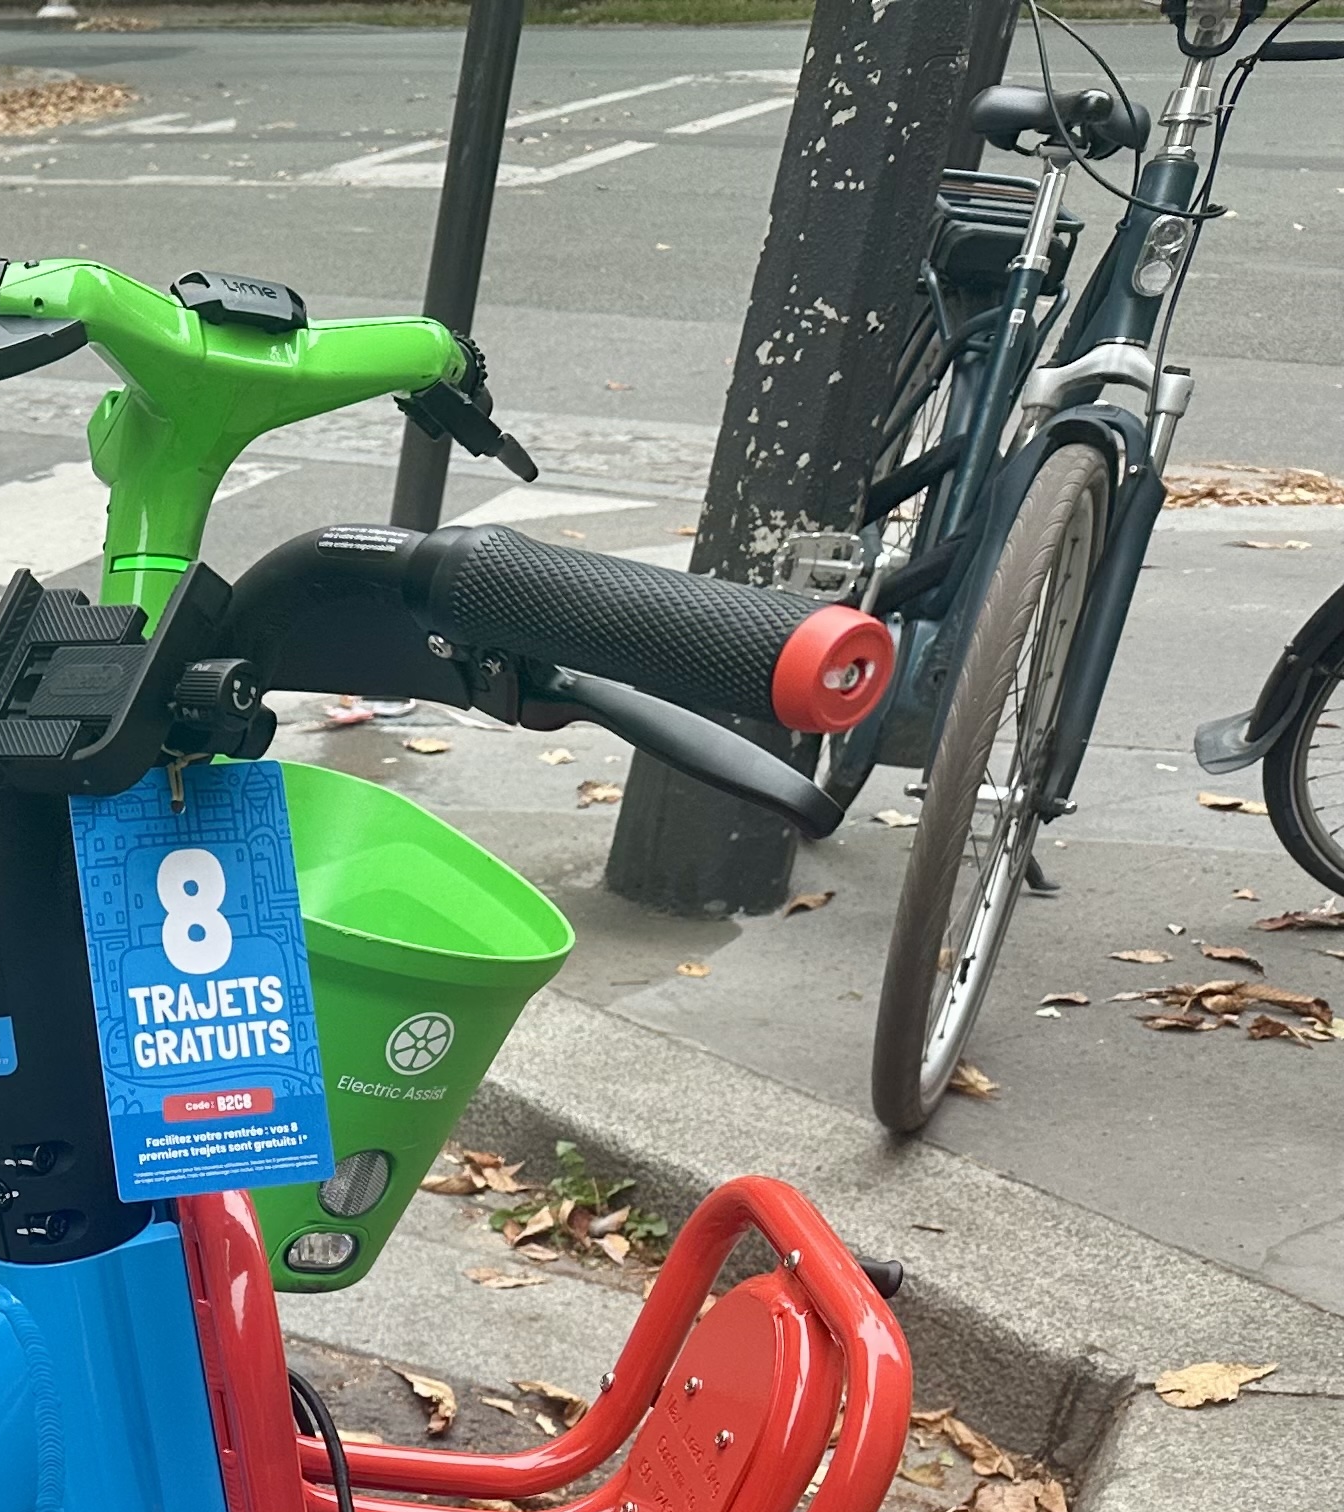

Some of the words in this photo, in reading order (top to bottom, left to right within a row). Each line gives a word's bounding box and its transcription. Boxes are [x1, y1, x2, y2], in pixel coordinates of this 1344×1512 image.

[157, 848, 232, 974] 8
[128, 976, 284, 1026] TRAJETS
[134, 1019, 291, 1069] GRATUITS
[216, 1093, 252, 1112] B2C8
[337, 1074, 402, 1099] Electric
[402, 1085, 448, 1101] Assist
[146, 1133, 192, 1148] Facilitez
[193, 1130, 222, 1142] votre
[224, 1124, 264, 1138] rentrée
[269, 1125, 290, 1134] vos
[290, 1122, 298, 1133] 8
[138, 1148, 190, 1166] premiers
[190, 1144, 226, 1158] trajets
[228, 1140, 252, 1152] sont
[254, 1136, 297, 1153] gratuits
